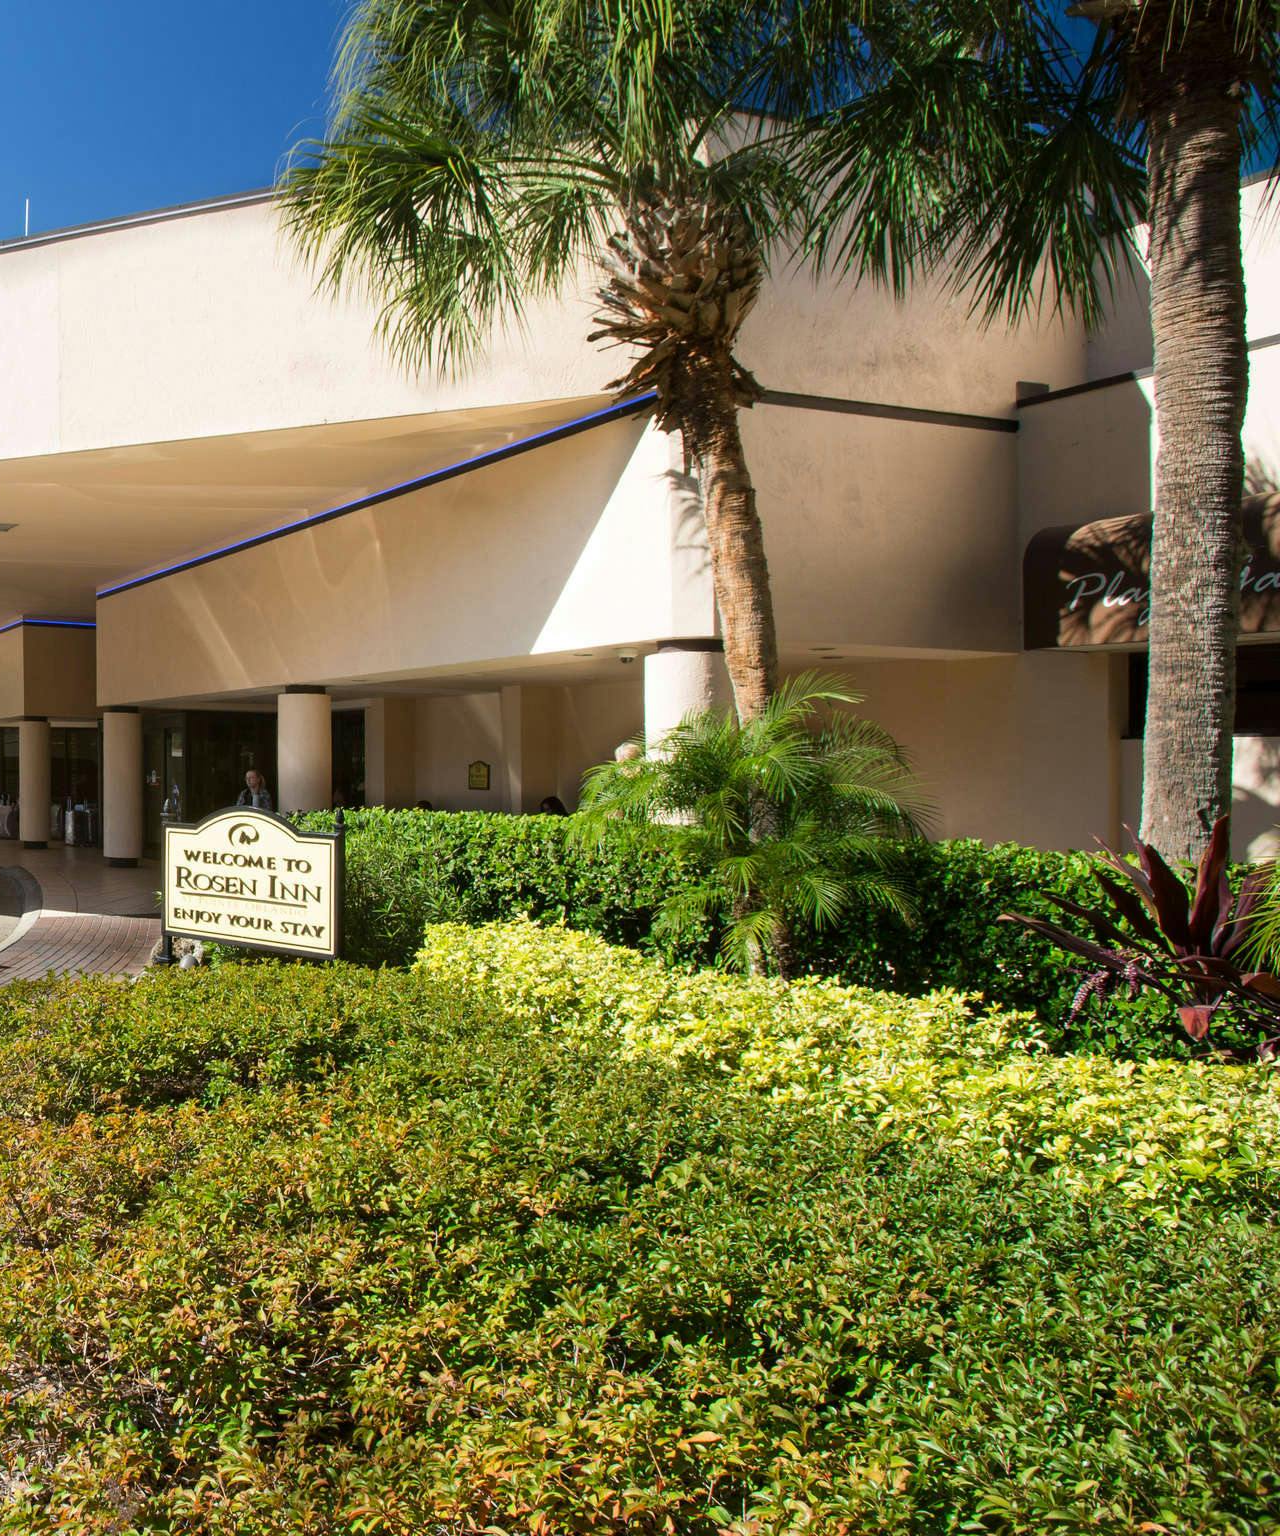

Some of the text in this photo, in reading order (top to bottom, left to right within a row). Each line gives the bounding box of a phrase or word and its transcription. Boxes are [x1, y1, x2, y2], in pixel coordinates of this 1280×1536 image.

[183, 849, 312, 874] WELCOME TO
[175, 865, 322, 904] ROSEN INN
[173, 907, 326, 939] ENJOY YOUR STAY
